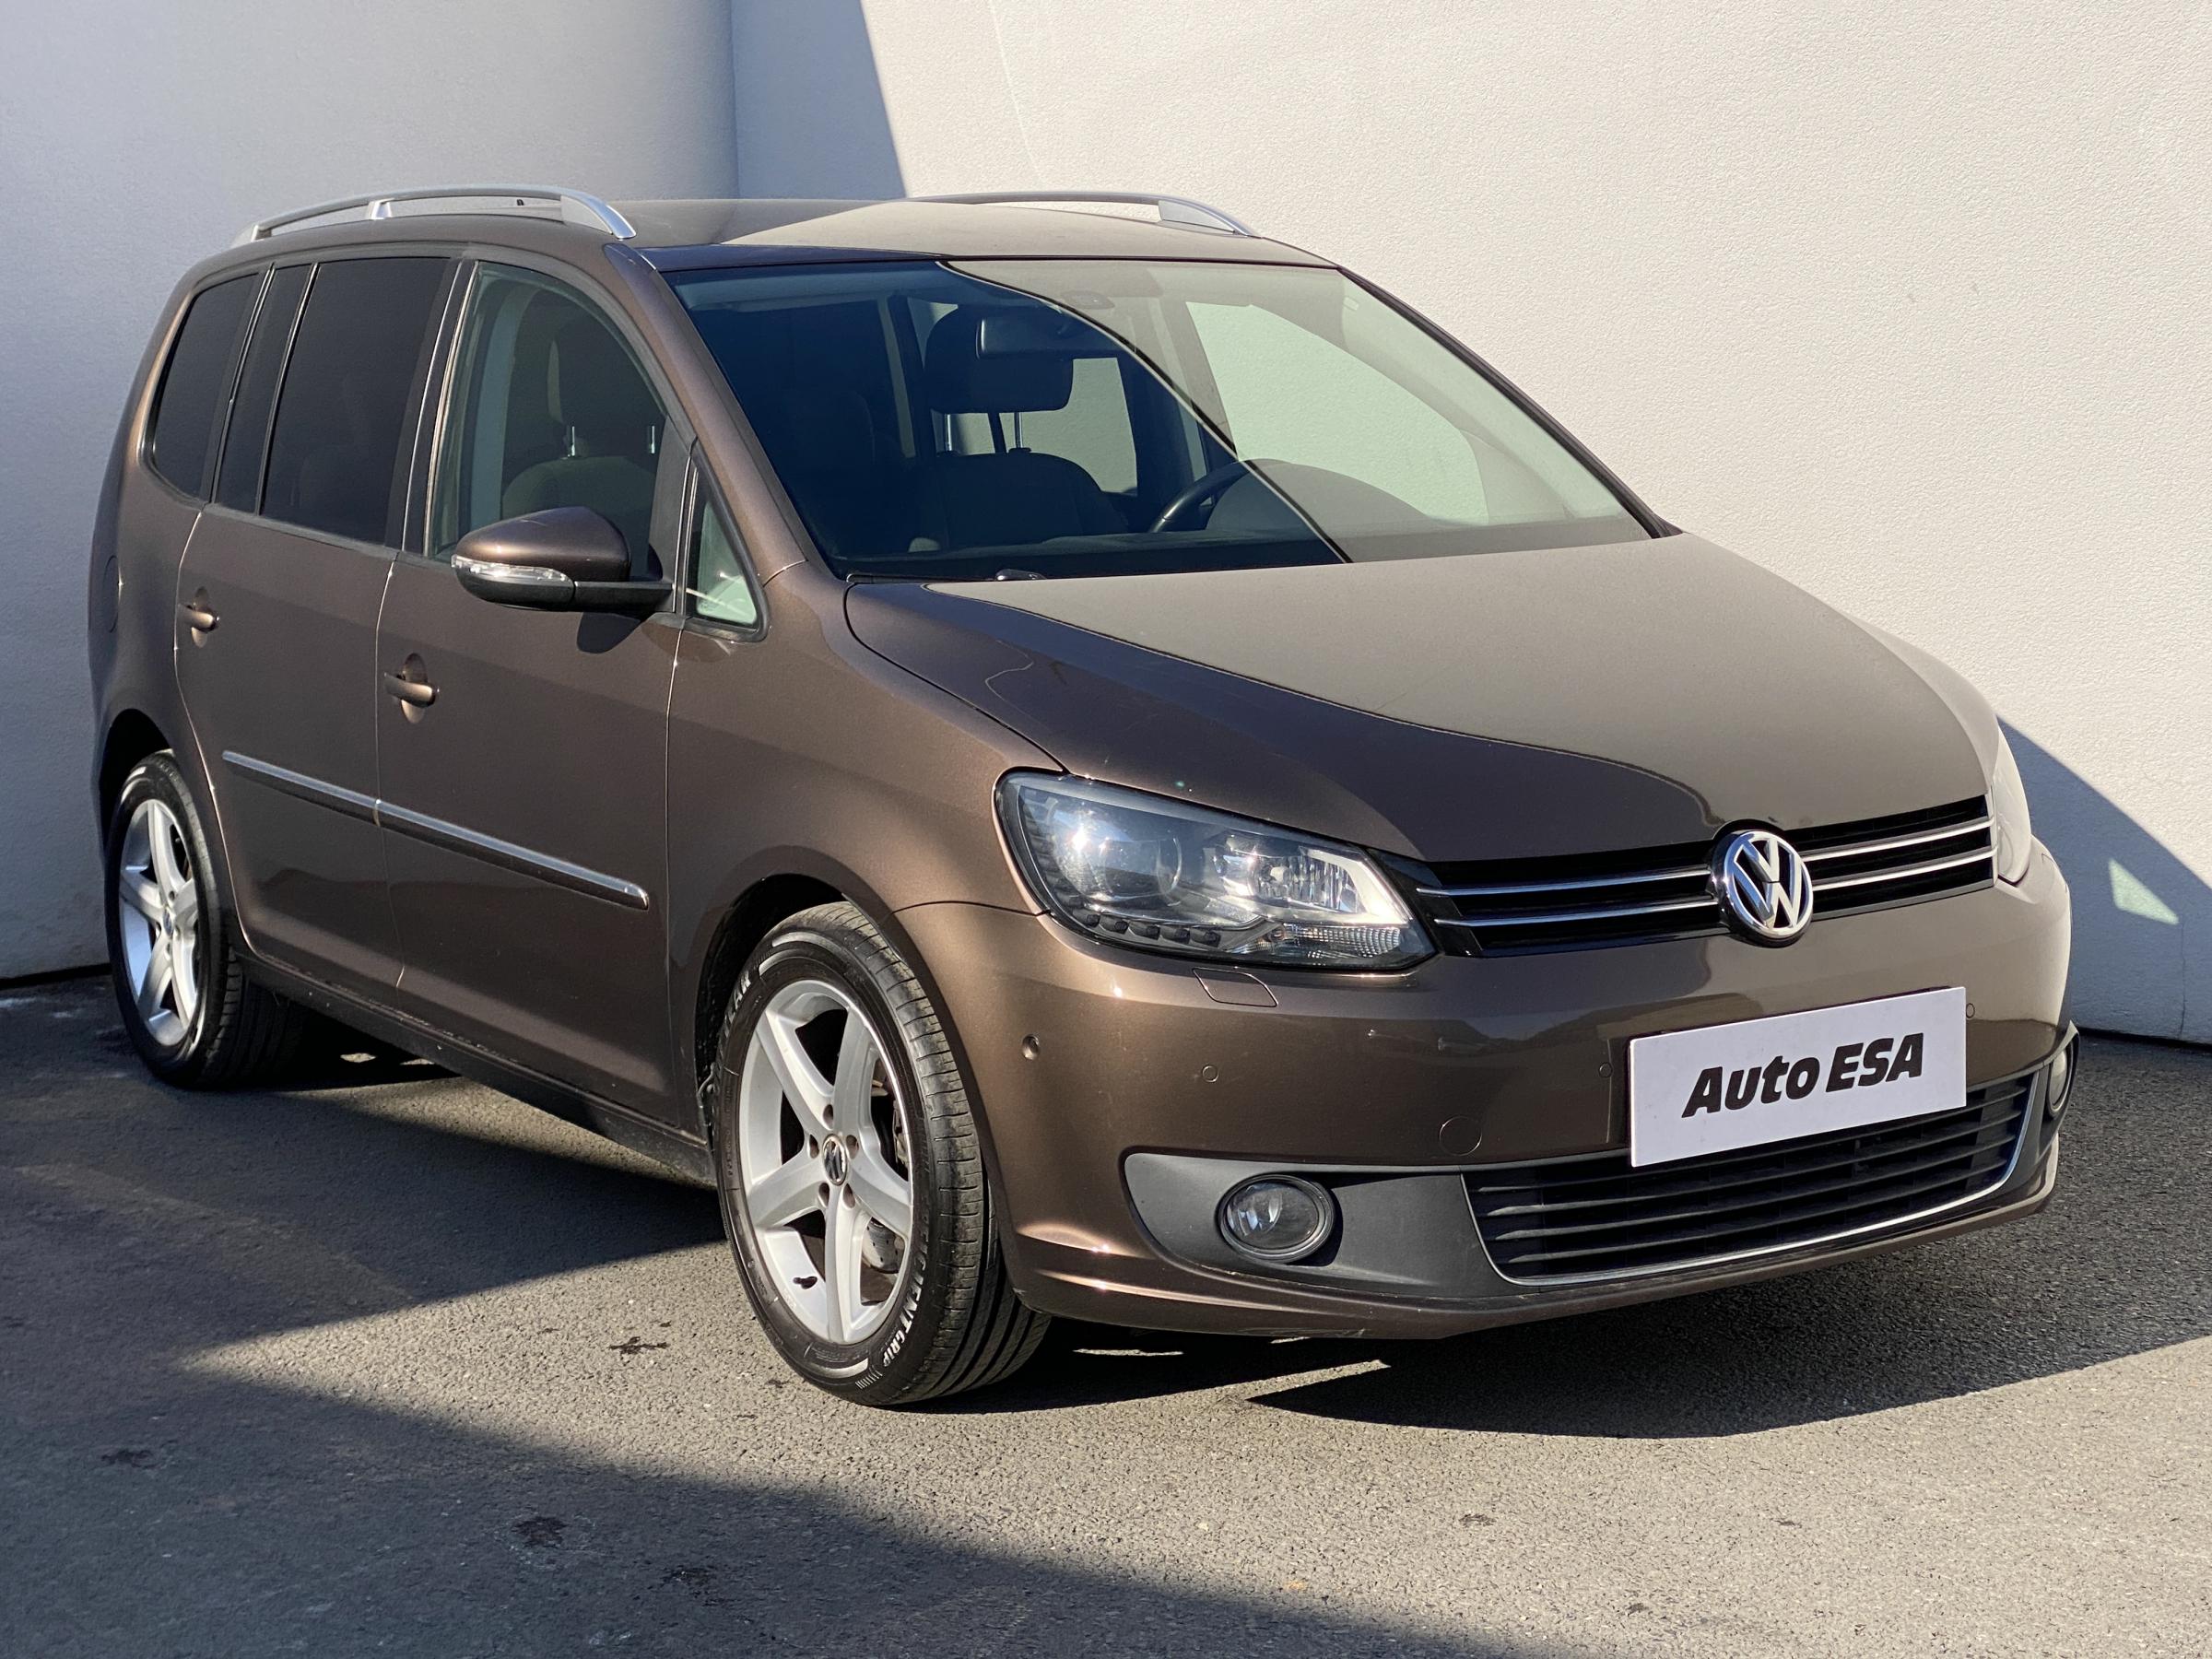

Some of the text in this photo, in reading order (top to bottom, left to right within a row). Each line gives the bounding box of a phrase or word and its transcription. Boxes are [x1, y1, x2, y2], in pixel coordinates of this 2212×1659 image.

[1724, 831, 1813, 938] VW
[1680, 1032, 1924, 1119] Auto ESA
